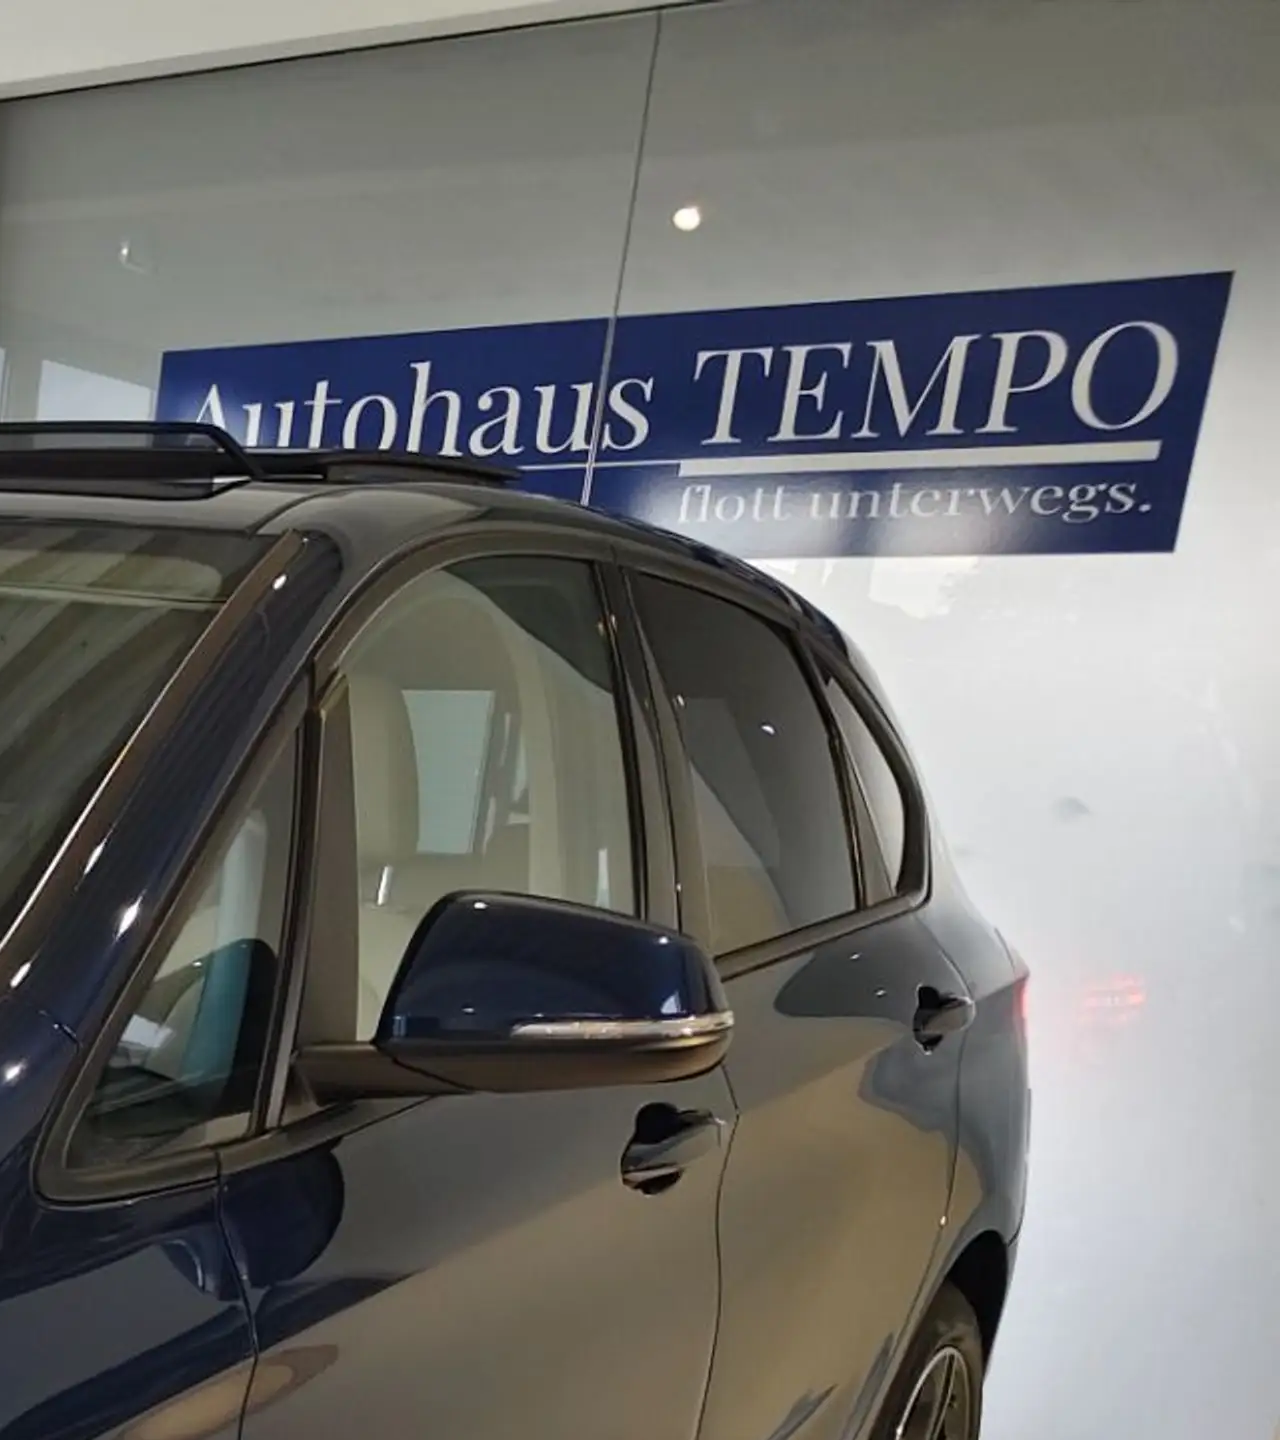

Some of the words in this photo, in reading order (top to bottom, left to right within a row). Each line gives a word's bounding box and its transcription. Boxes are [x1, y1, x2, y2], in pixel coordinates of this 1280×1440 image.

[195, 361, 654, 457] Autohaus
[693, 320, 1179, 446] TEMPO
[677, 484, 792, 524] flott
[809, 480, 1152, 524] unterwegs.
